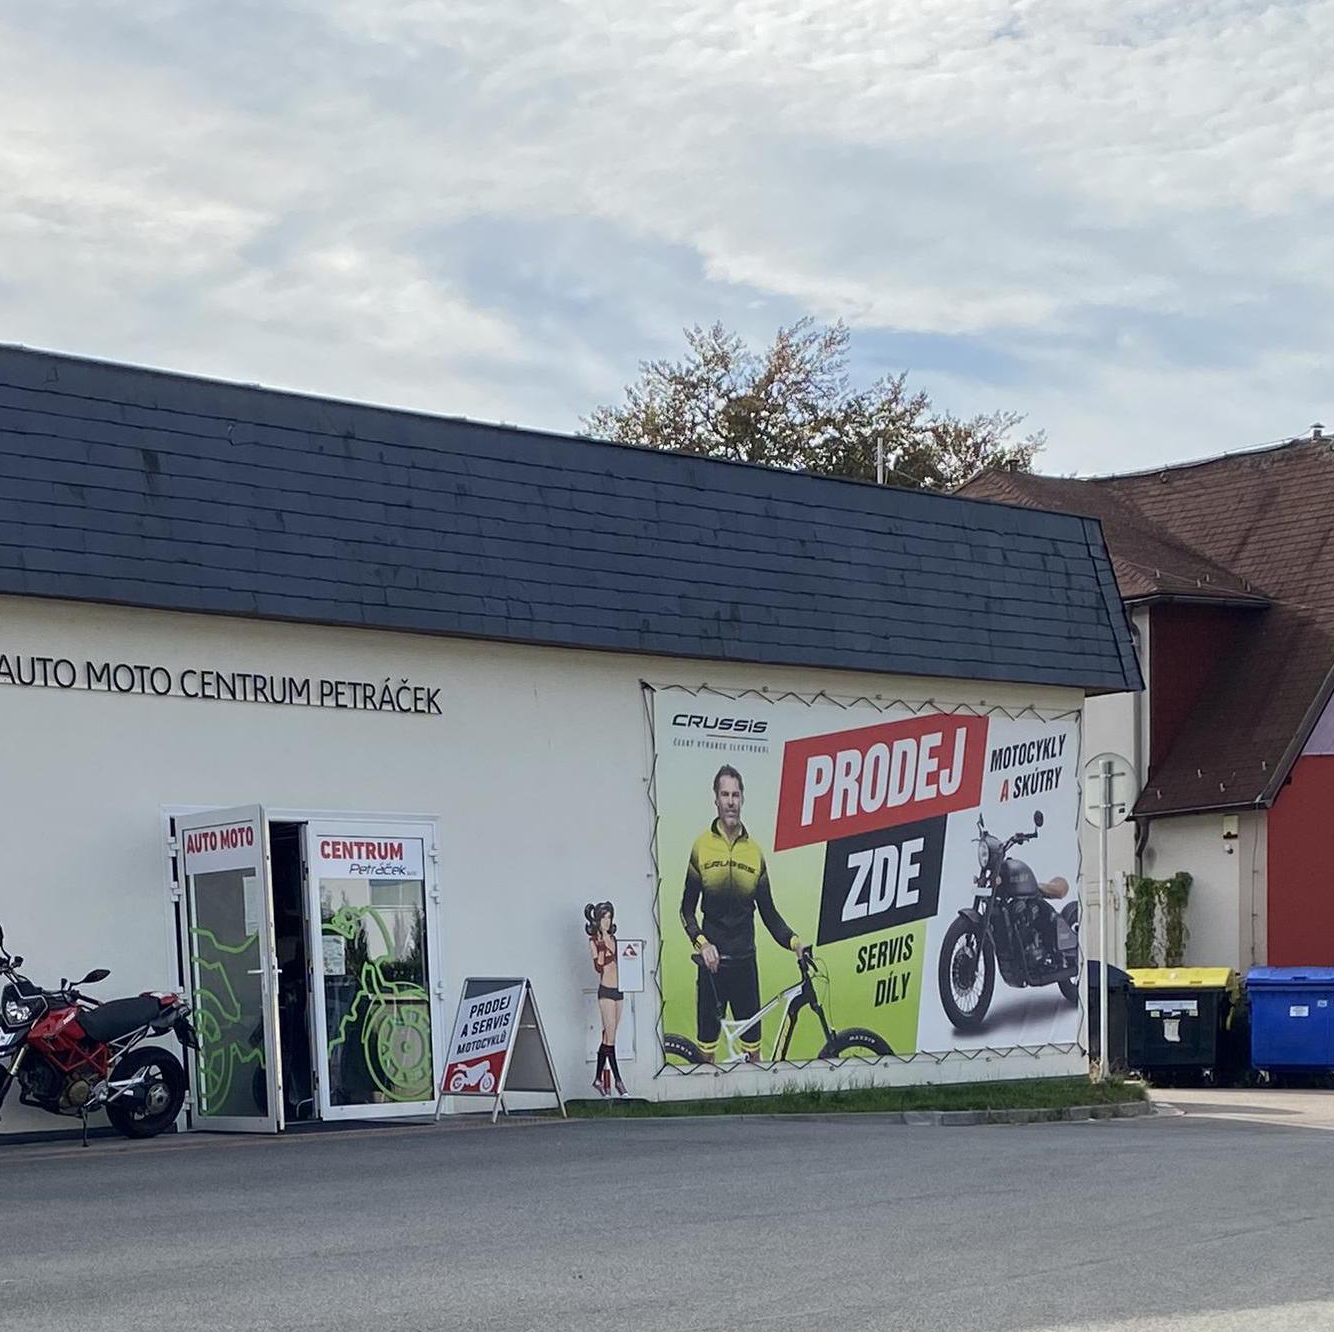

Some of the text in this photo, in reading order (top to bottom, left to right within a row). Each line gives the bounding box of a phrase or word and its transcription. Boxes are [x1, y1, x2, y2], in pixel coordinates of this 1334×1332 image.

[86, 661, 172, 696] MOTO
[180, 669, 311, 707] CENTRUM
[320, 677, 443, 715] PETRÁČEK
[990, 733, 1067, 773] MOTOCYKLY
[801, 727, 967, 827] PRODEJ
[1000, 766, 1063, 802] A SKÚTRY
[186, 825, 254, 854] AUTO MOTO
[320, 840, 403, 860] CENTRUM
[349, 862, 407, 876] Petráček
[841, 837, 925, 922] ZDE
[856, 933, 914, 974] SERVIS
[470, 995, 511, 1019] PRODEJ
[874, 970, 911, 1008] DÍLY
[457, 1029, 507, 1055] MOTOCYKLŮ
[460, 1012, 511, 1038] A SERVIS
